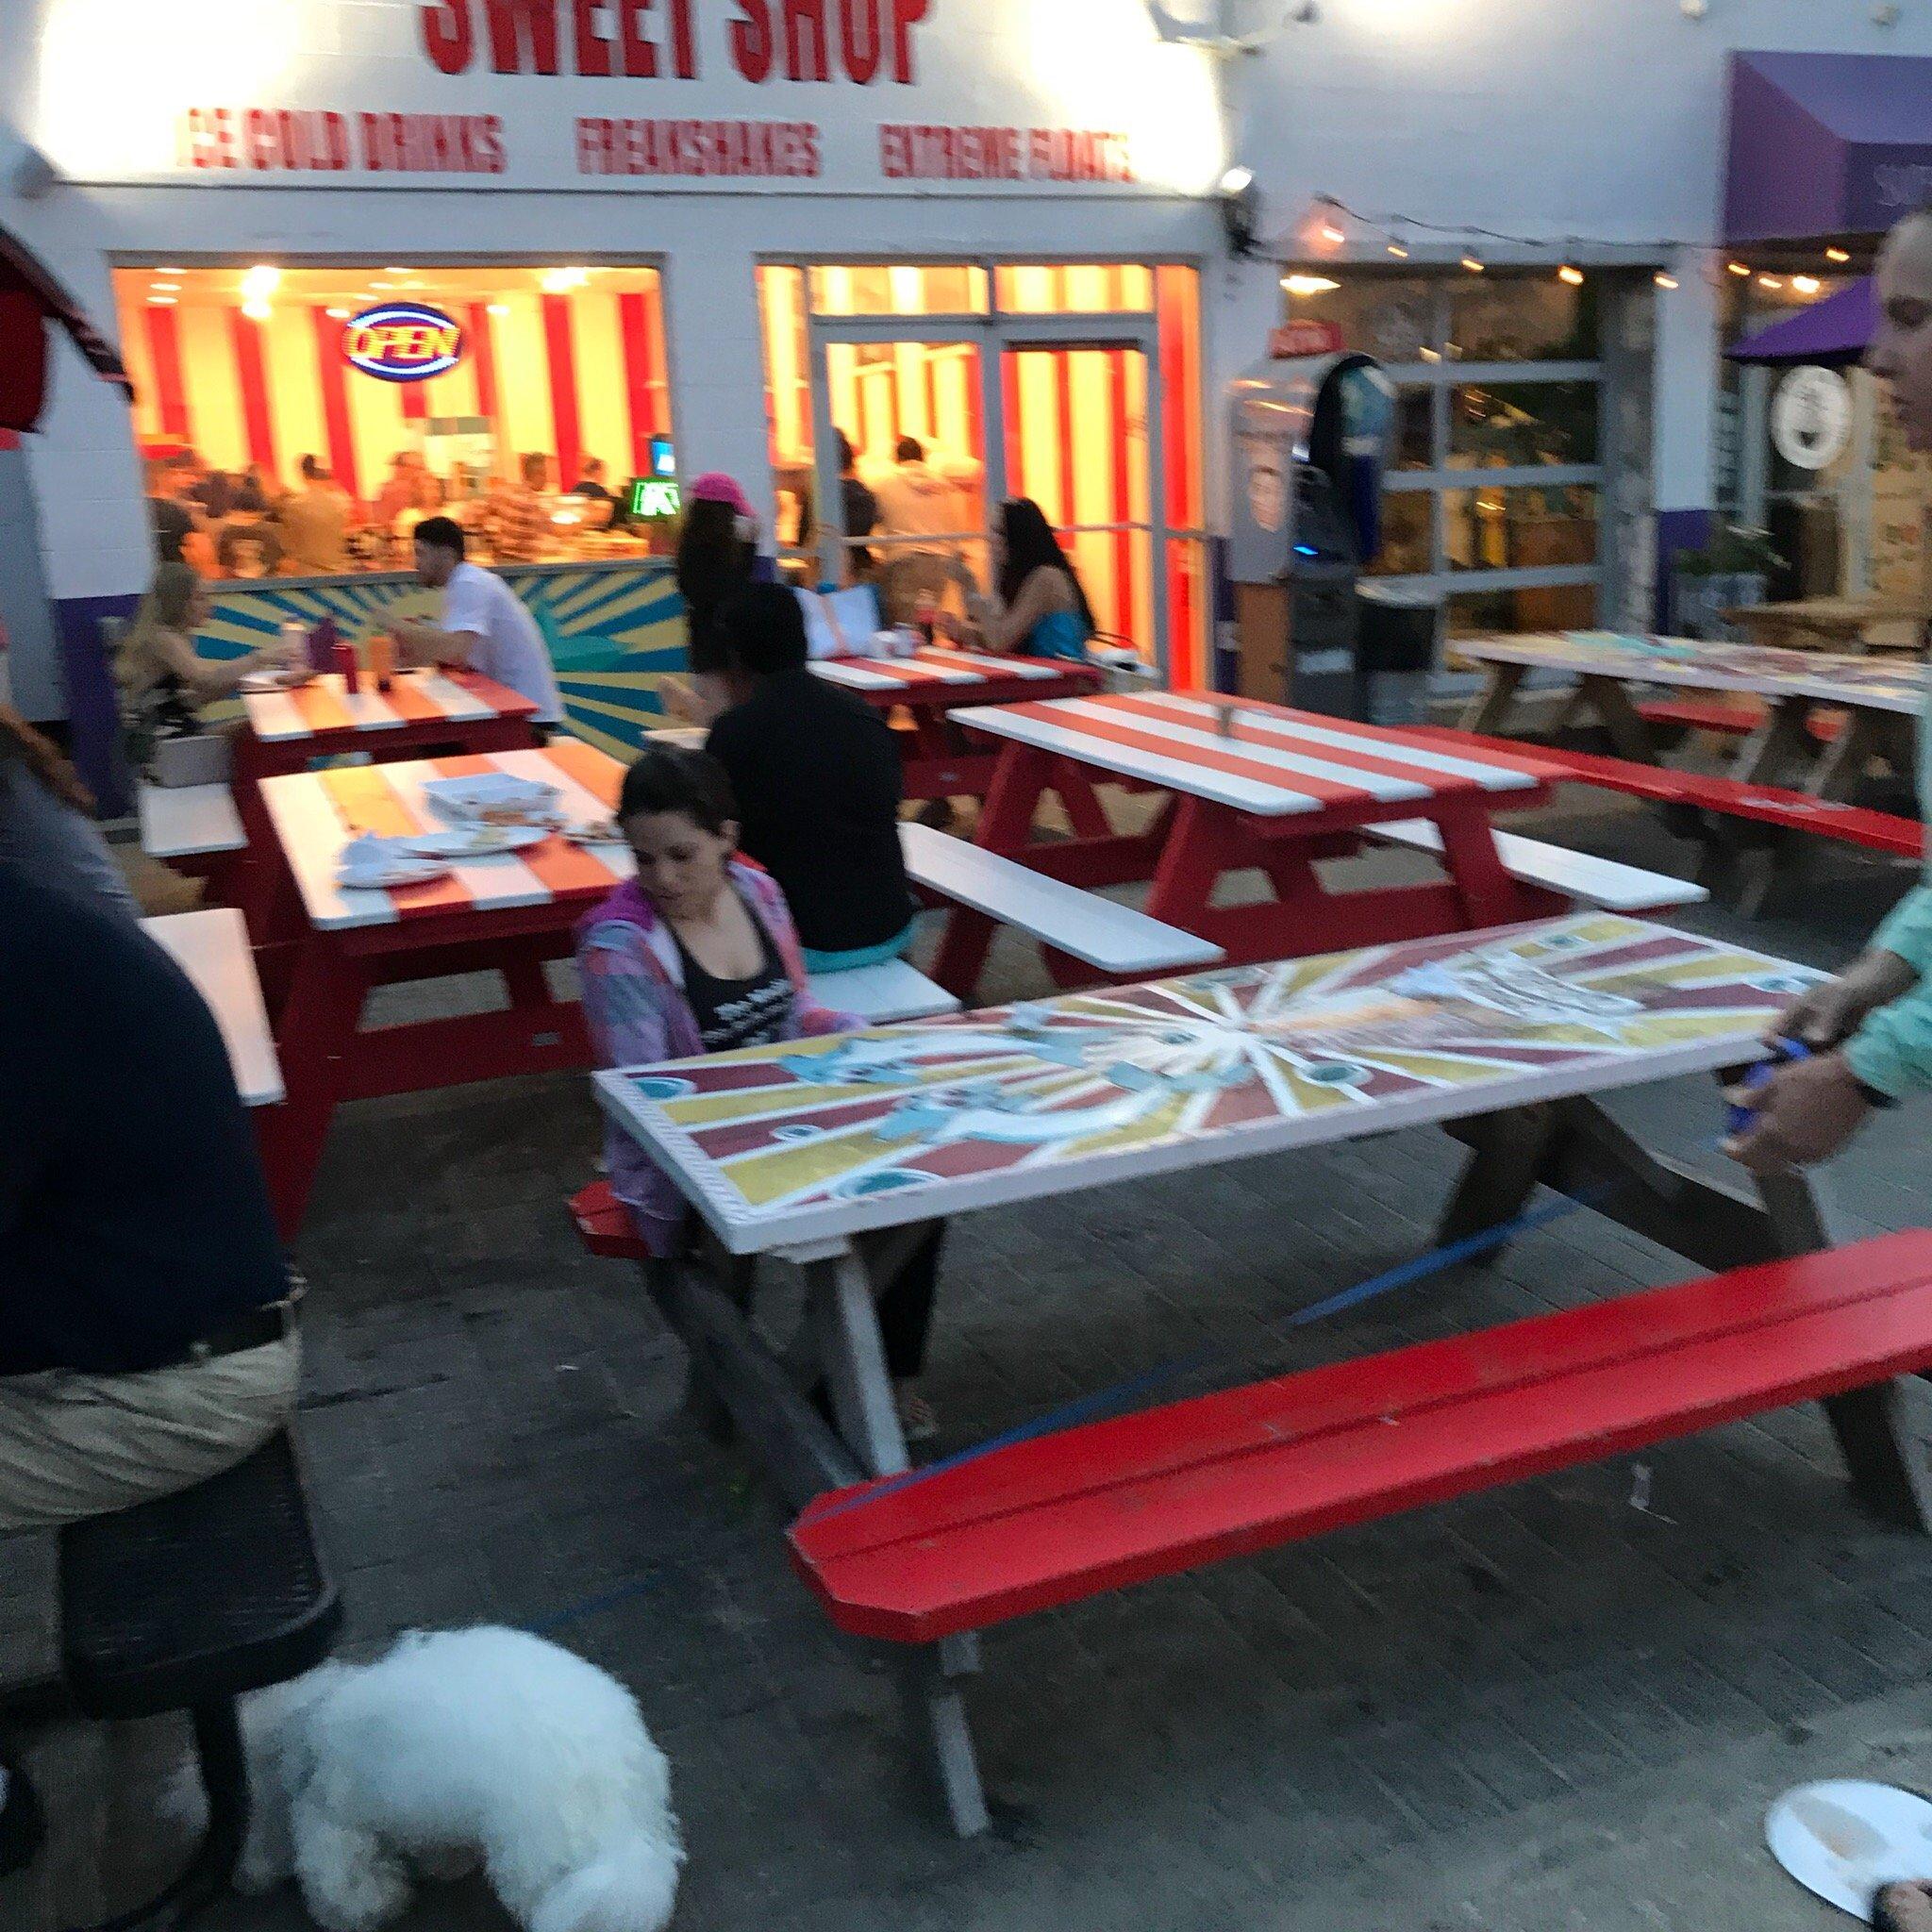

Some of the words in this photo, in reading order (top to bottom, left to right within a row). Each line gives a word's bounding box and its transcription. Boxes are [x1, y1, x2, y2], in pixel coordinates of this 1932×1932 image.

[724, 0, 930, 85] SHOP
[358, 111, 508, 175] DRINKS
[341, 325, 461, 360] OPEN
